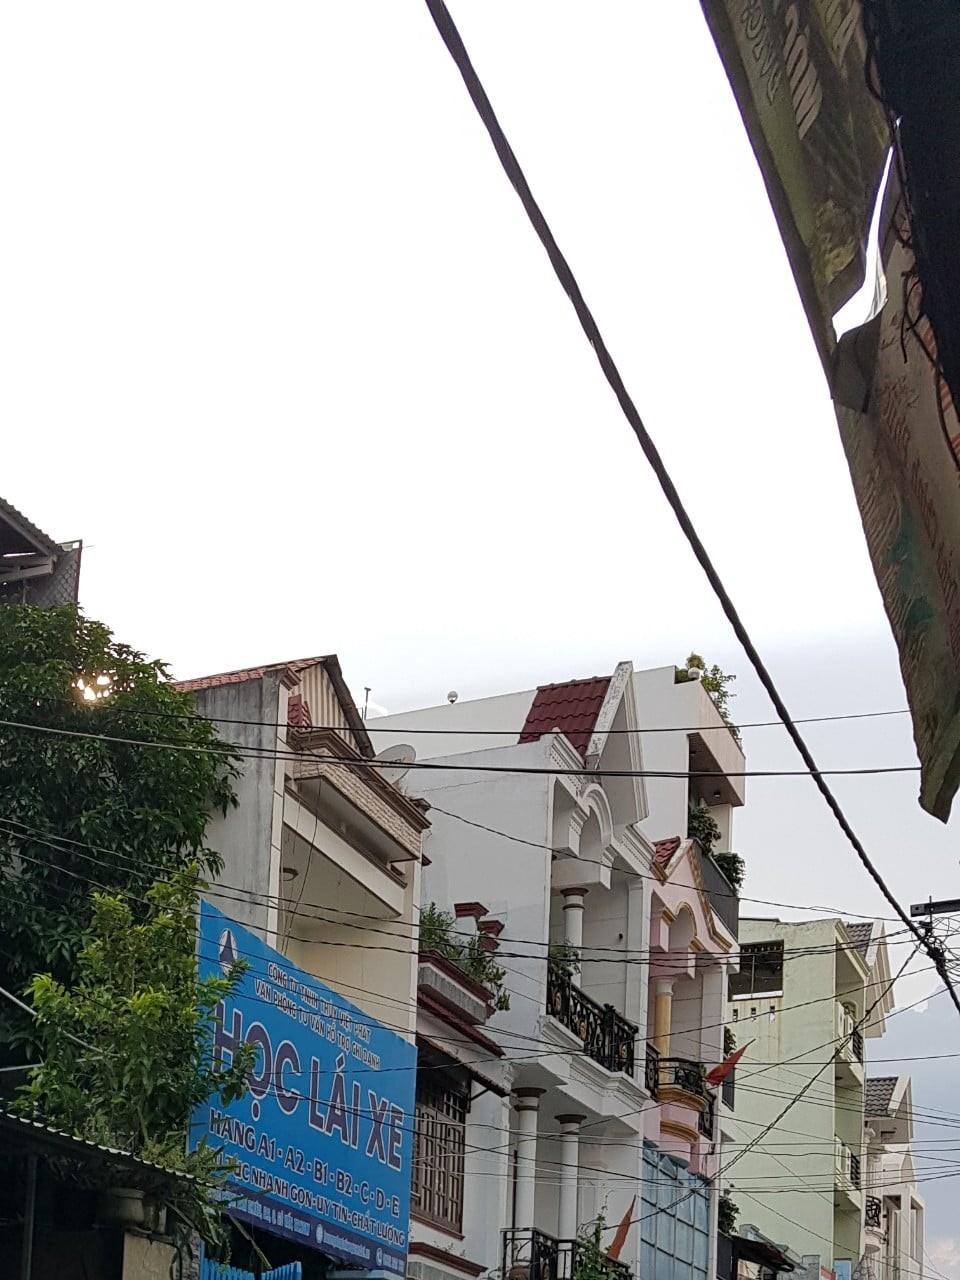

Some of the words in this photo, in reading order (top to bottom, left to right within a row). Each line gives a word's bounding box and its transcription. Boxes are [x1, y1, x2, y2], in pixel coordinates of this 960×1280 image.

[268, 962, 288, 987] CÔNG
[289, 976, 299, 995] TY
[300, 985, 318, 1009] TNHH
[352, 1041, 362, 1060] GHI
[363, 1048, 380, 1070] DANH
[212, 1000, 302, 1121] HỌC
[309, 1052, 360, 1149] LÁI
[366, 1090, 404, 1172] XE
[209, 1108, 255, 1152] HẠNG
[257, 1133, 276, 1162] A1
[284, 1146, 304, 1175] A2
[314, 1158, 328, 1185] B1
[336, 1168, 352, 1197] B2
[360, 1181, 369, 1204] C
[375, 1187, 385, 1210] D
[391, 1195, 400, 1218] E
[251, 1166, 289, 1199] NHANH
